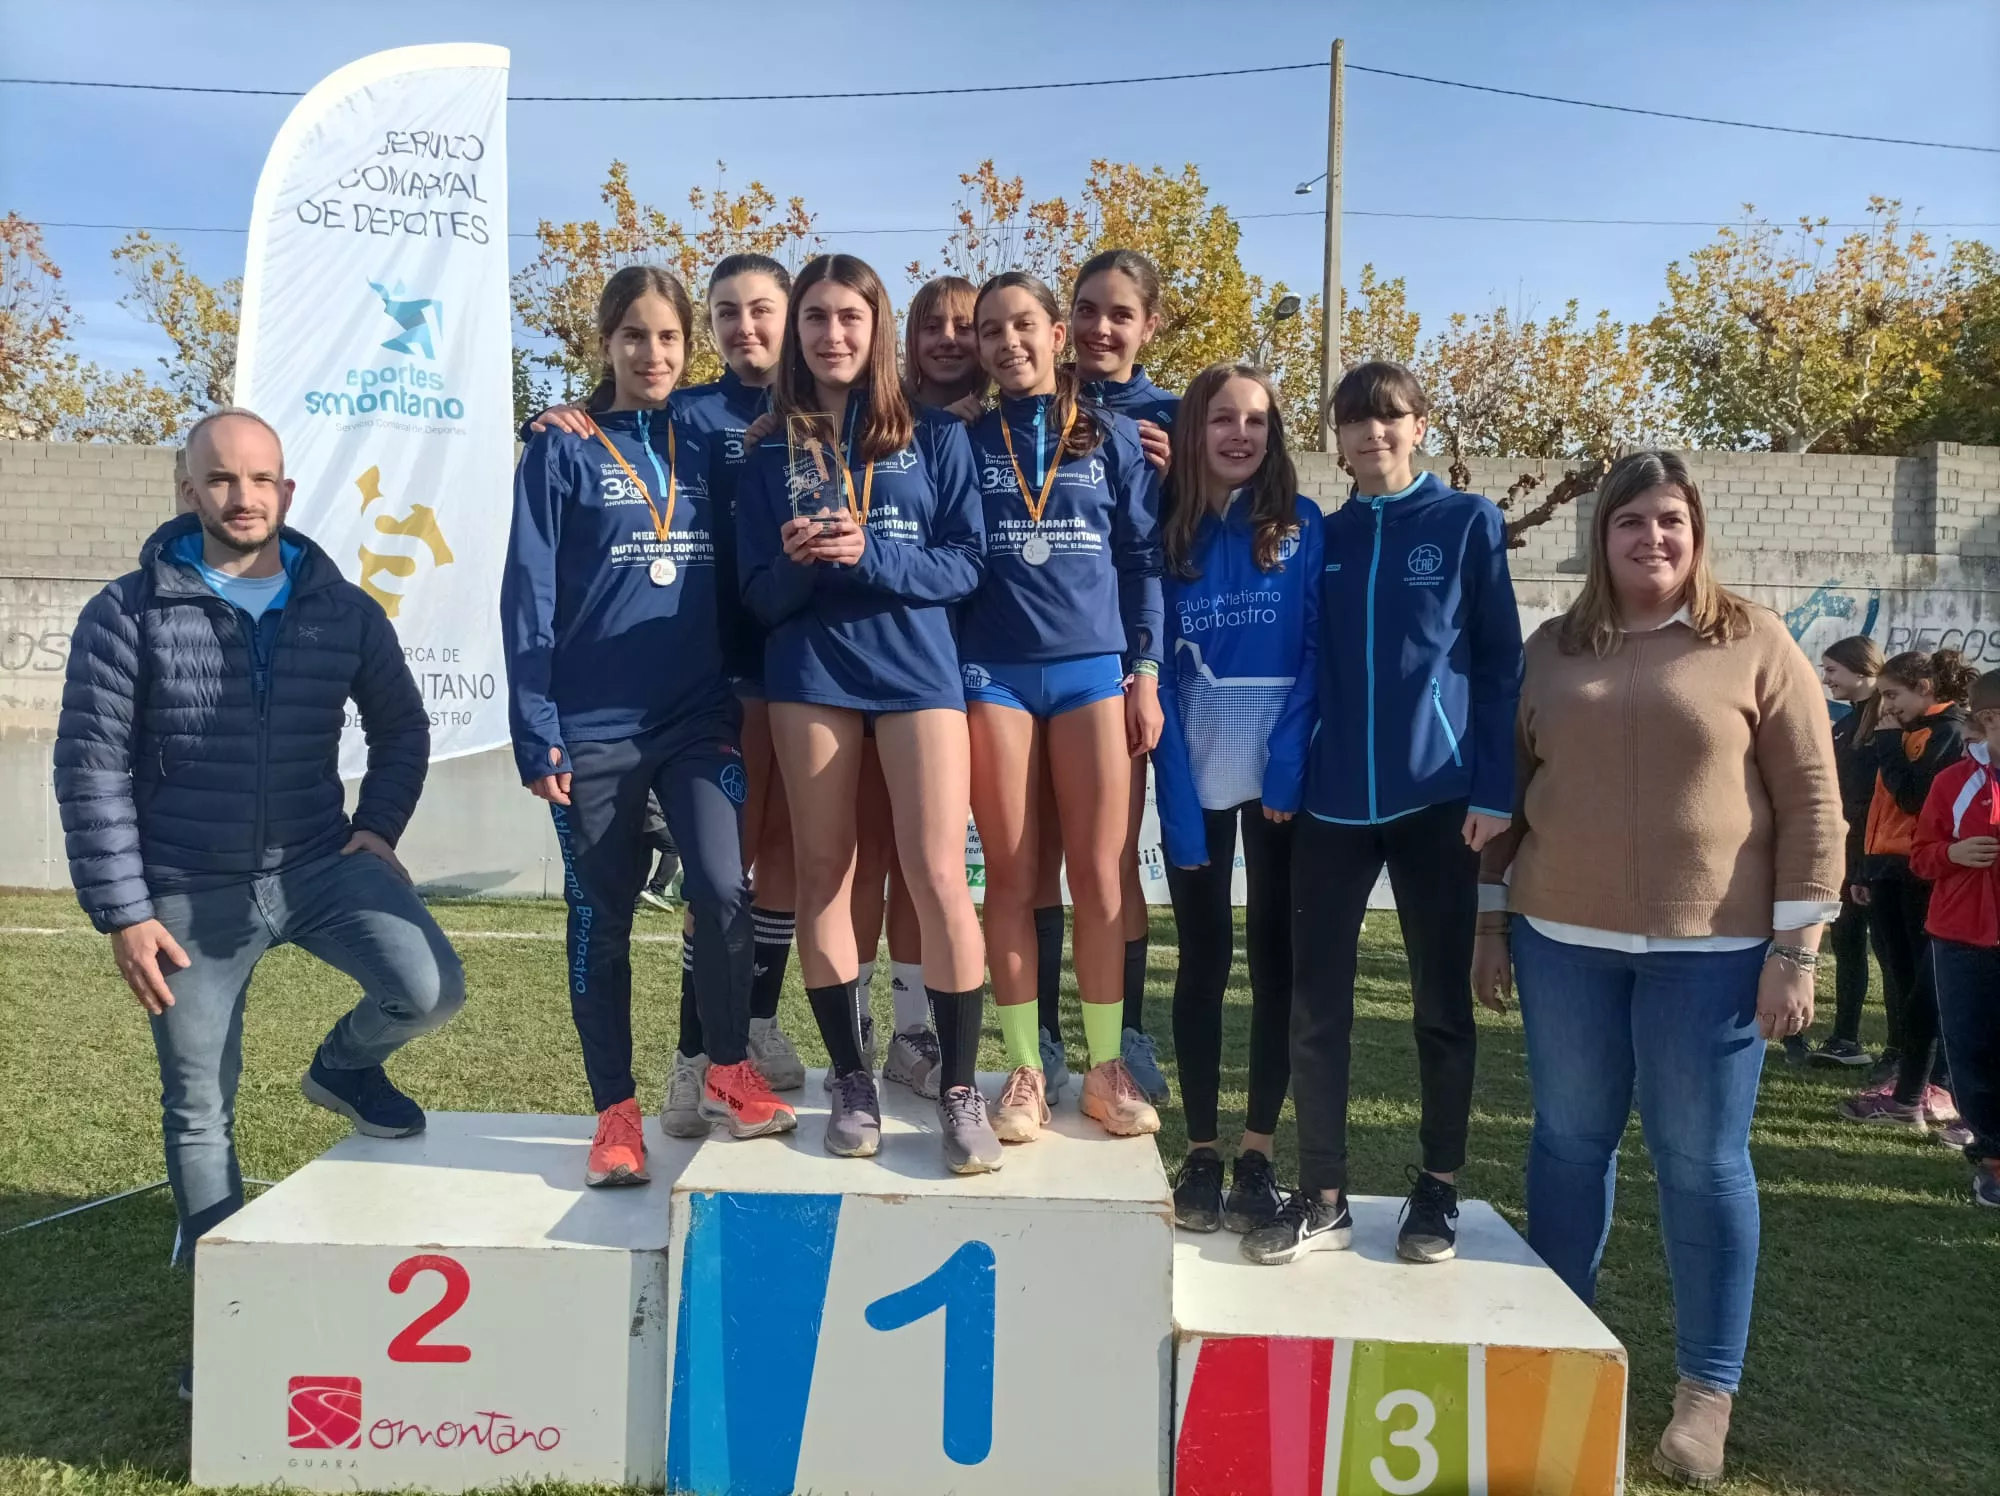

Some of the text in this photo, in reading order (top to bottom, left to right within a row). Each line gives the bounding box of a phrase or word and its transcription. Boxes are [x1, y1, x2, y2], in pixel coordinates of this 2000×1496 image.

[1176, 589, 1281, 614] Club Atletismo
[1181, 605, 1276, 634] Barbastro
[443, 648, 460, 662] DE
[387, 1254, 472, 1363] 2
[864, 1240, 996, 1465] 1
[1370, 1389, 1440, 1495] 3
